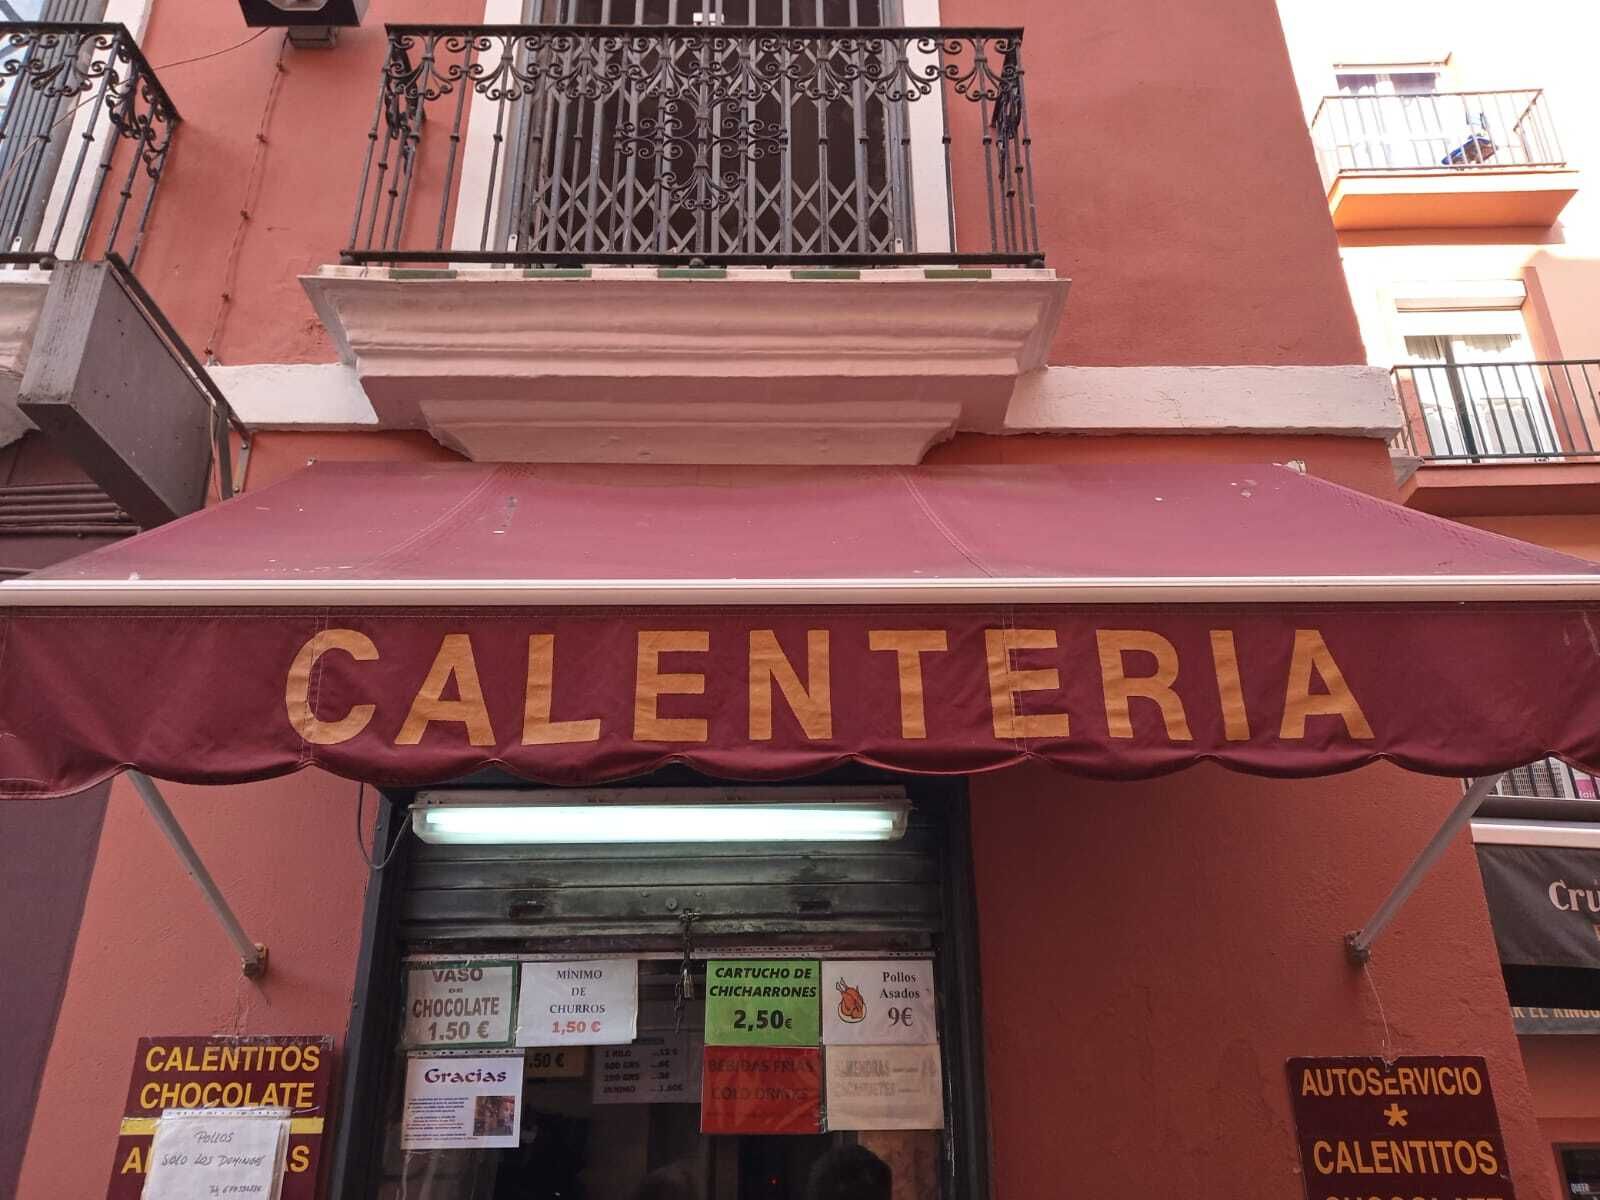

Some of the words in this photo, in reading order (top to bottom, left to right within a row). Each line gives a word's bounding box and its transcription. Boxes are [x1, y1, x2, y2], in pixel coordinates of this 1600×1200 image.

[285, 628, 1375, 747] CALENTERIA
[432, 967, 483, 983] VASO
[715, 967, 790, 980] CARTUCHO
[793, 967, 812, 980] DE
[882, 971, 918, 984] Pollos
[571, 986, 587, 997] DE
[709, 985, 817, 998] CHICHARRONES
[880, 987, 921, 999] Asados
[412, 996, 500, 1018] CHOCOLATE
[549, 1003, 606, 1014] CHURROS
[887, 1007, 914, 1028] 9€
[428, 1021, 470, 1041] 1.50
[477, 1020, 490, 1040] €
[552, 1021, 586, 1035] 1,50
[145, 1045, 321, 1073] CALENTITOS
[424, 1068, 507, 1086] Gracias
[1301, 1066, 1482, 1097] AUTOSERVICIO
[140, 1081, 315, 1109] CHOCOLATE
[1313, 1139, 1498, 1176] CALENTITOS
